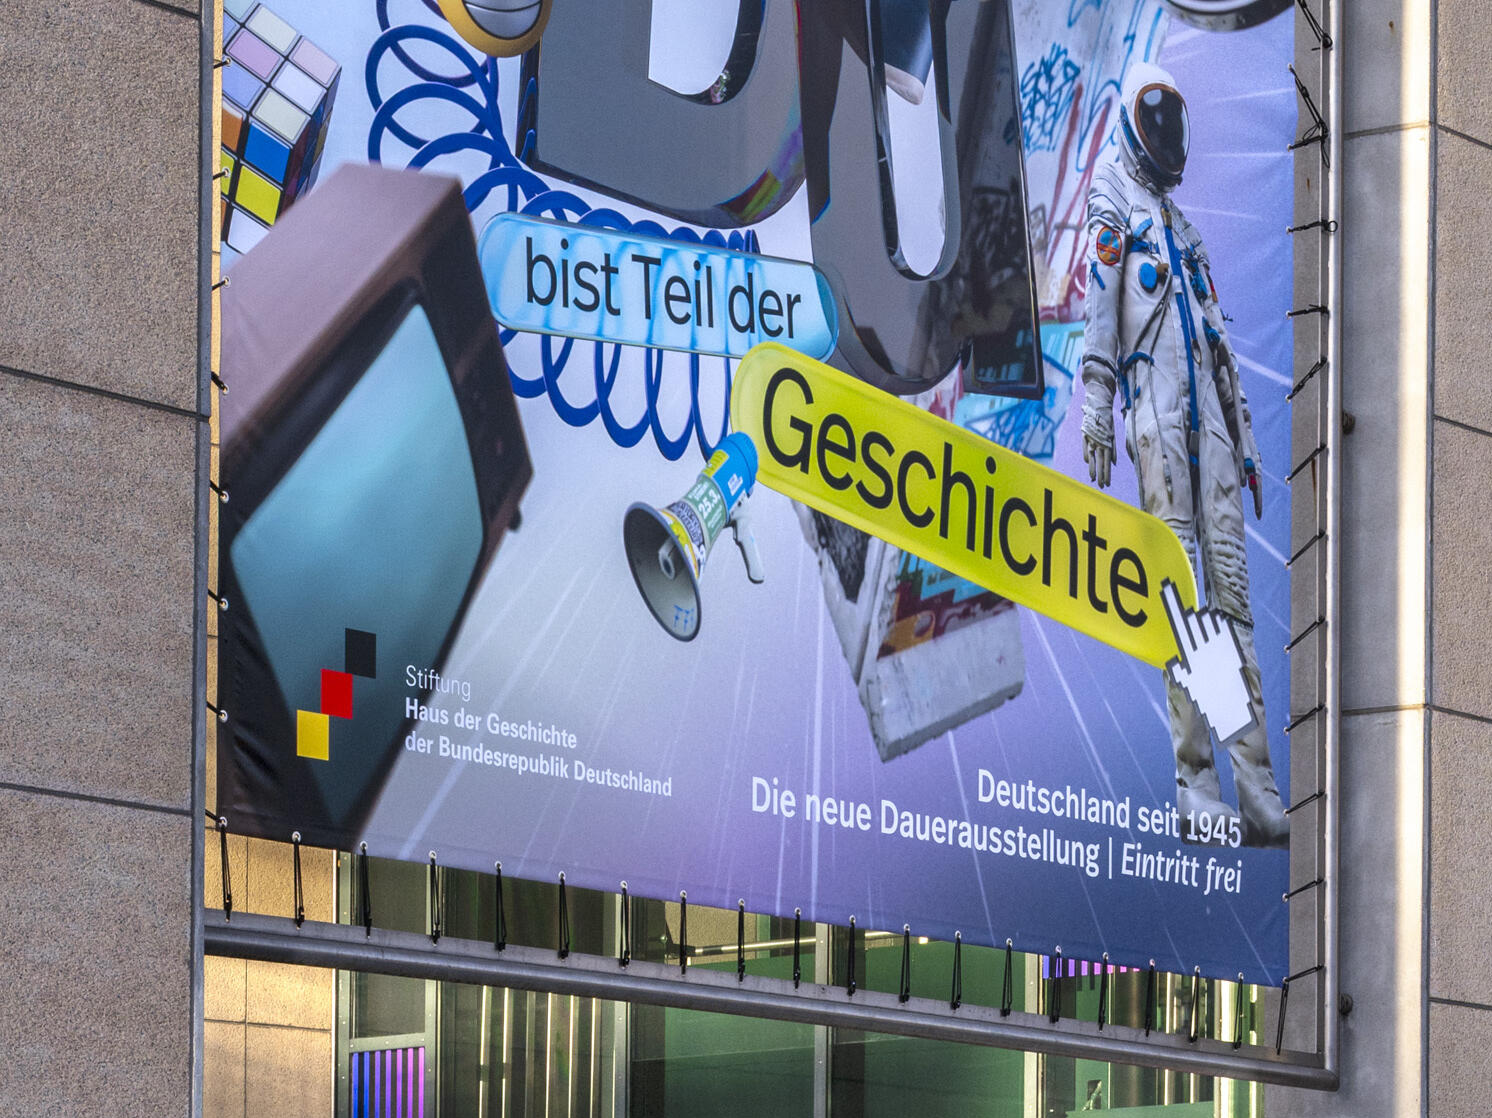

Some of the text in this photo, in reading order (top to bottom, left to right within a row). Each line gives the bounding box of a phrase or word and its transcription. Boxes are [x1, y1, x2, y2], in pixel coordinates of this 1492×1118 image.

[526, 236, 801, 339] bist Teil der
[763, 367, 1150, 628] Geschichte
[405, 664, 471, 702] Stiftung
[405, 697, 578, 749] Haus der Geschichte
[405, 731, 672, 797] der Bundesrepublik Deutschland
[752, 776, 796, 818] Die
[805, 794, 872, 831] neue
[881, 799, 1101, 878] Dauerausstellung
[1121, 841, 1200, 887] Eintritt
[1203, 857, 1243, 896] frei
[978, 769, 1241, 848] Deutschland seit 1945
